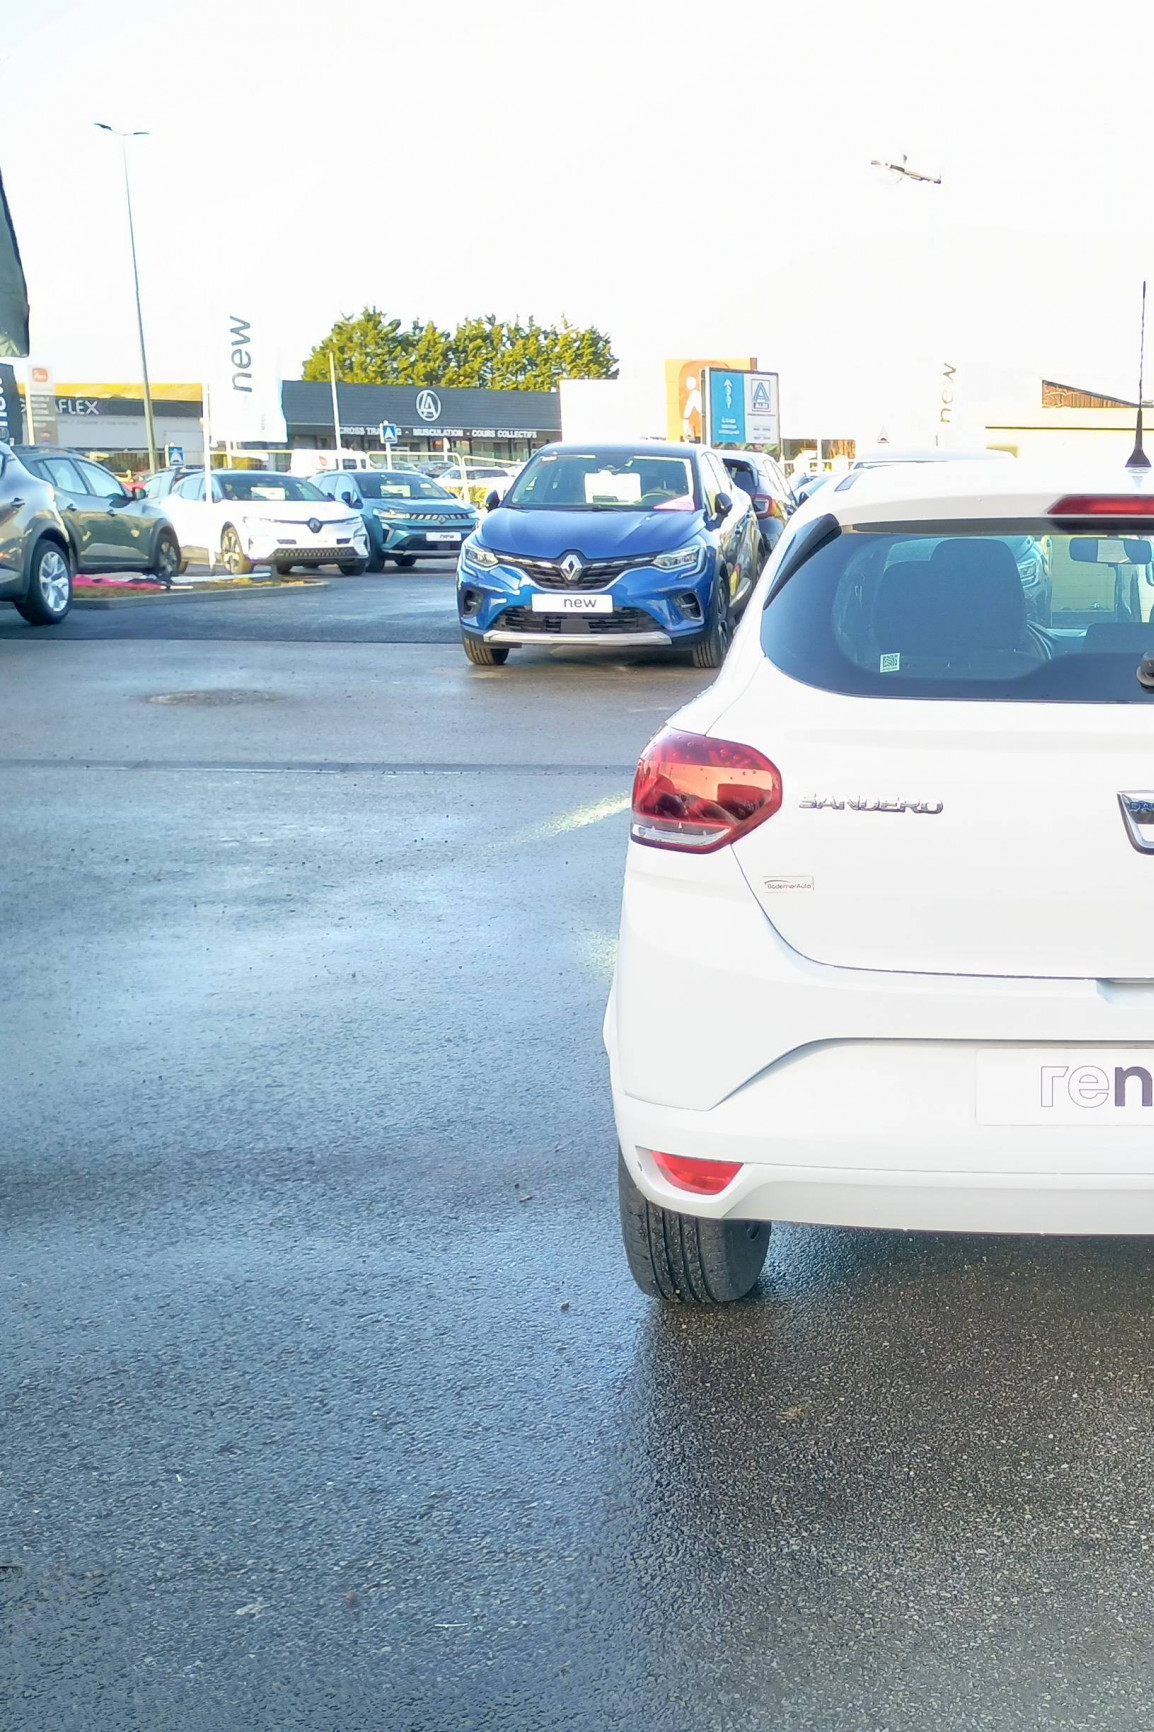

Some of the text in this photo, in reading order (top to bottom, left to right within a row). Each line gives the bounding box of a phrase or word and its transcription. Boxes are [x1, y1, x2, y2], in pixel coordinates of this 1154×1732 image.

[229, 315, 253, 393] new
[472, 429, 495, 438] COURS
[497, 430, 537, 439] COLLECTIFS
[563, 598, 597, 608] new
[798, 793, 944, 815] SANDERO
